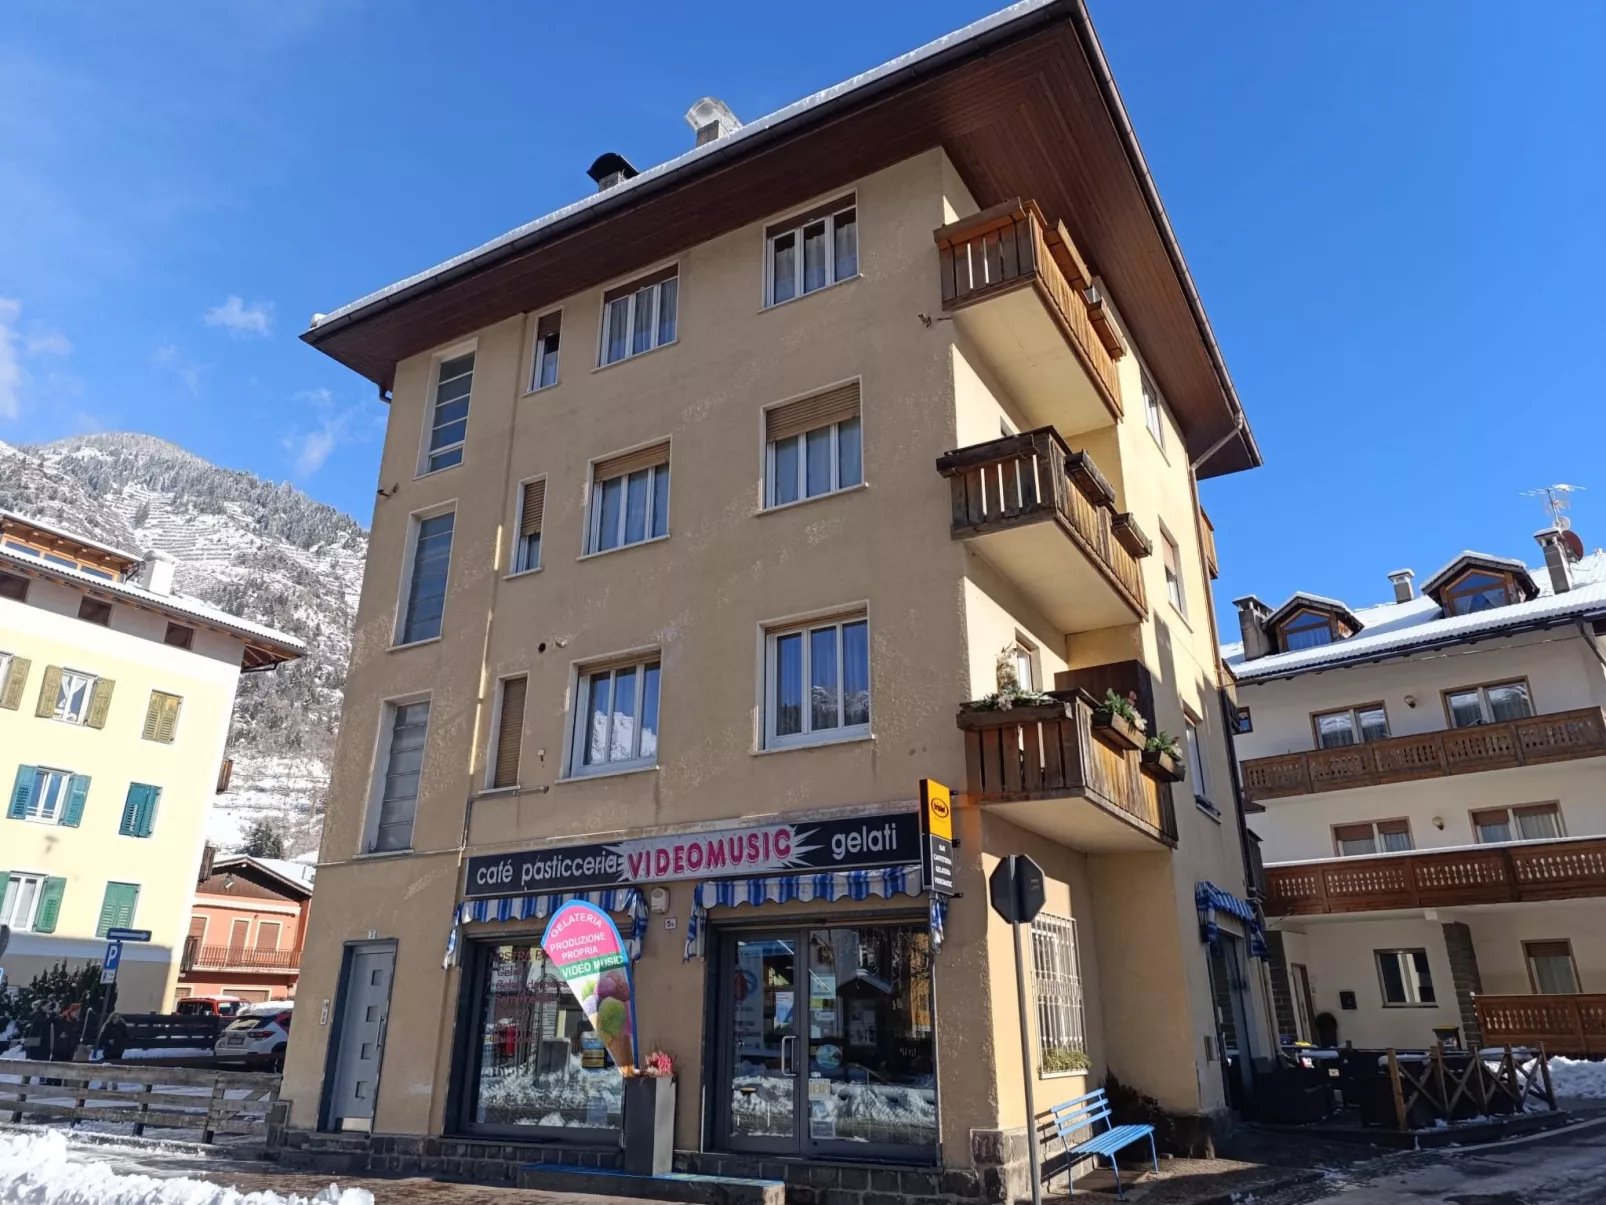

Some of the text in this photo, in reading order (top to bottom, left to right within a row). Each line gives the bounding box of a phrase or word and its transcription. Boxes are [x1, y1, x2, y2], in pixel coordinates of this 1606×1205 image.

[831, 823, 897, 860] gelati
[627, 828, 792, 880] VIDEOMUSIC
[476, 850, 617, 886] café pasticceria
[551, 913, 603, 938] GELATERIA
[549, 931, 606, 953] PRODUZIONE
[561, 945, 599, 961] PROPRIA
[106, 945, 118, 967] P
[561, 955, 624, 979] VIDEO MUSIC
